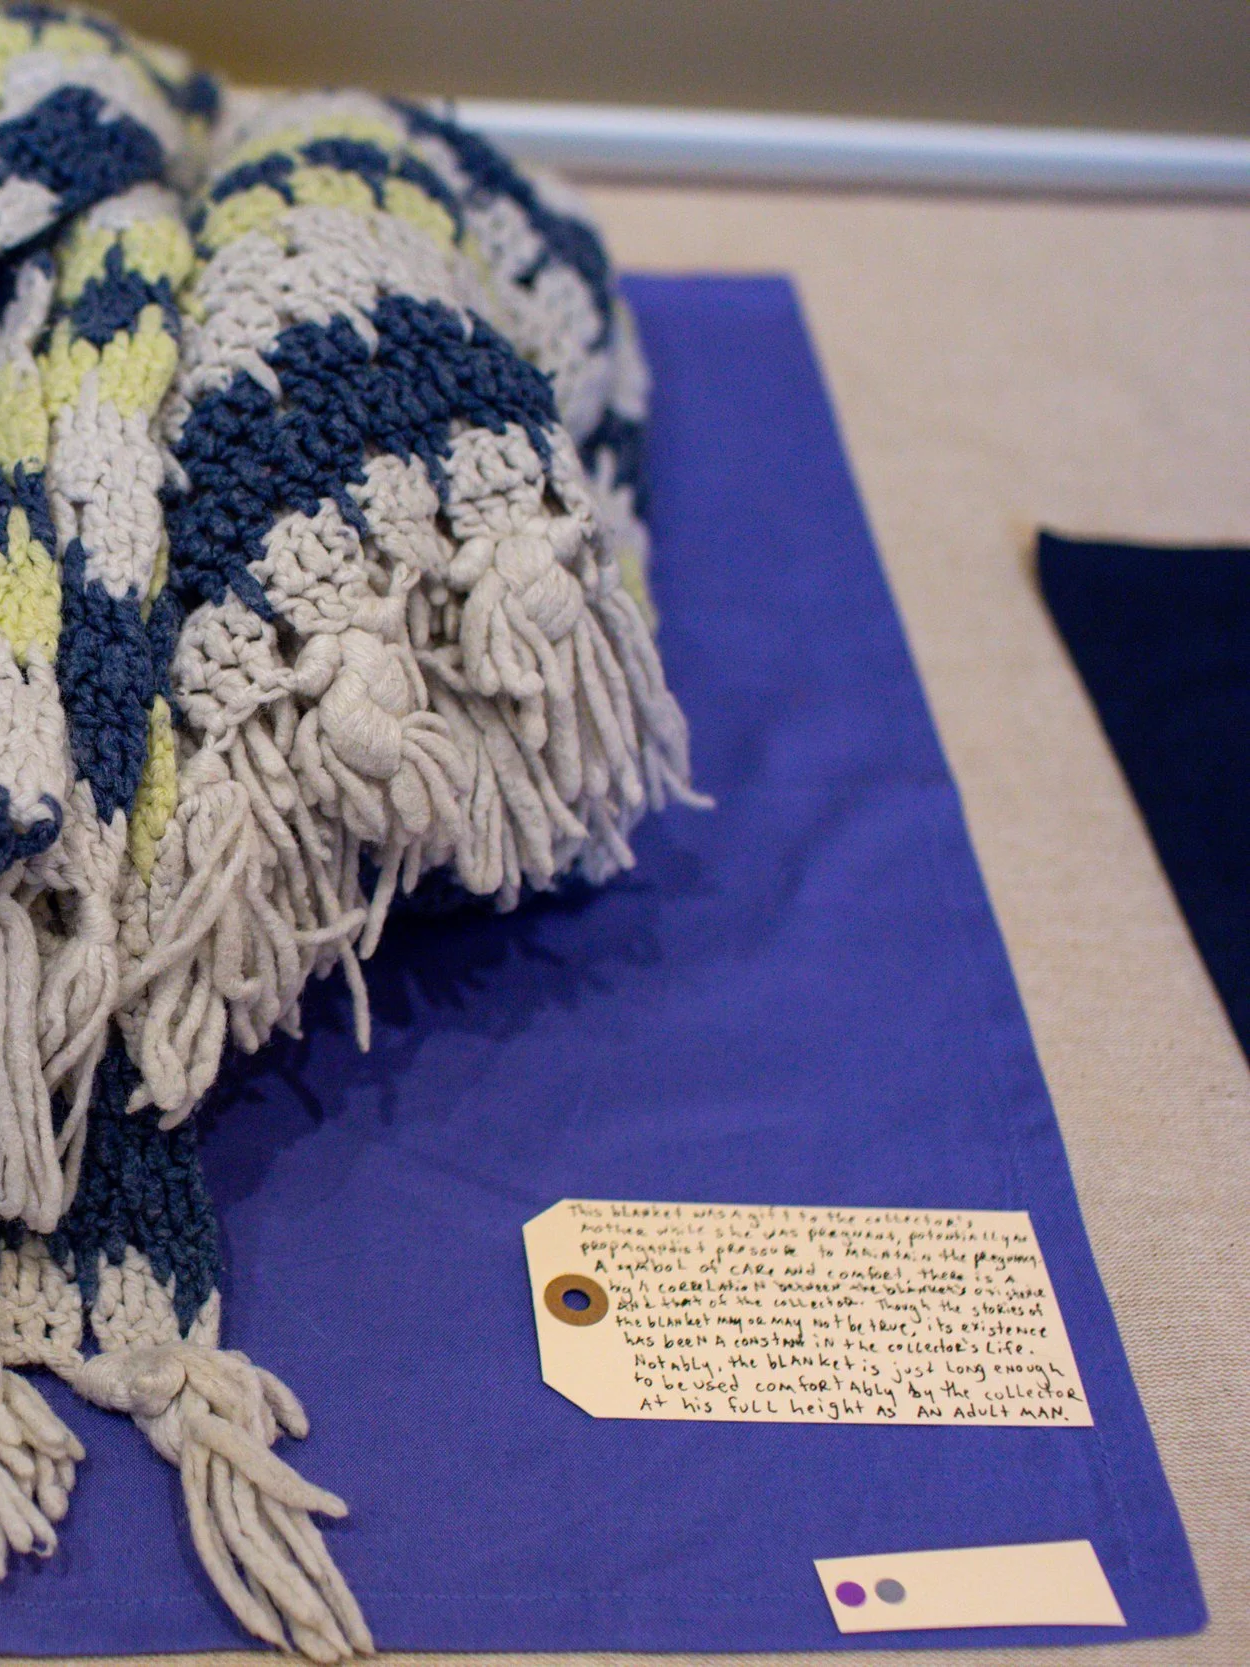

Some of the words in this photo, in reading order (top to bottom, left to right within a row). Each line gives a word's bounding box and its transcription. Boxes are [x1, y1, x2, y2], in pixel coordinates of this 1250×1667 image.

[699, 1259, 718, 1274] of
[709, 1294, 727, 1309] of
[939, 1298, 963, 1314] the
[1029, 1302, 1043, 1317] of
[615, 1314, 642, 1328] the
[846, 1314, 865, 1336] be
[927, 1316, 953, 1335] its
[843, 1338, 878, 1353] the
[728, 1353, 758, 1369] the
[862, 1358, 881, 1377] is
[890, 1360, 935, 1384] just
[634, 1371, 654, 1388] to
[661, 1374, 689, 1391] be
[692, 1373, 740, 1393] used
[939, 1380, 970, 1399] the
[681, 1396, 713, 1413] his
[789, 1397, 865, 1420] height
